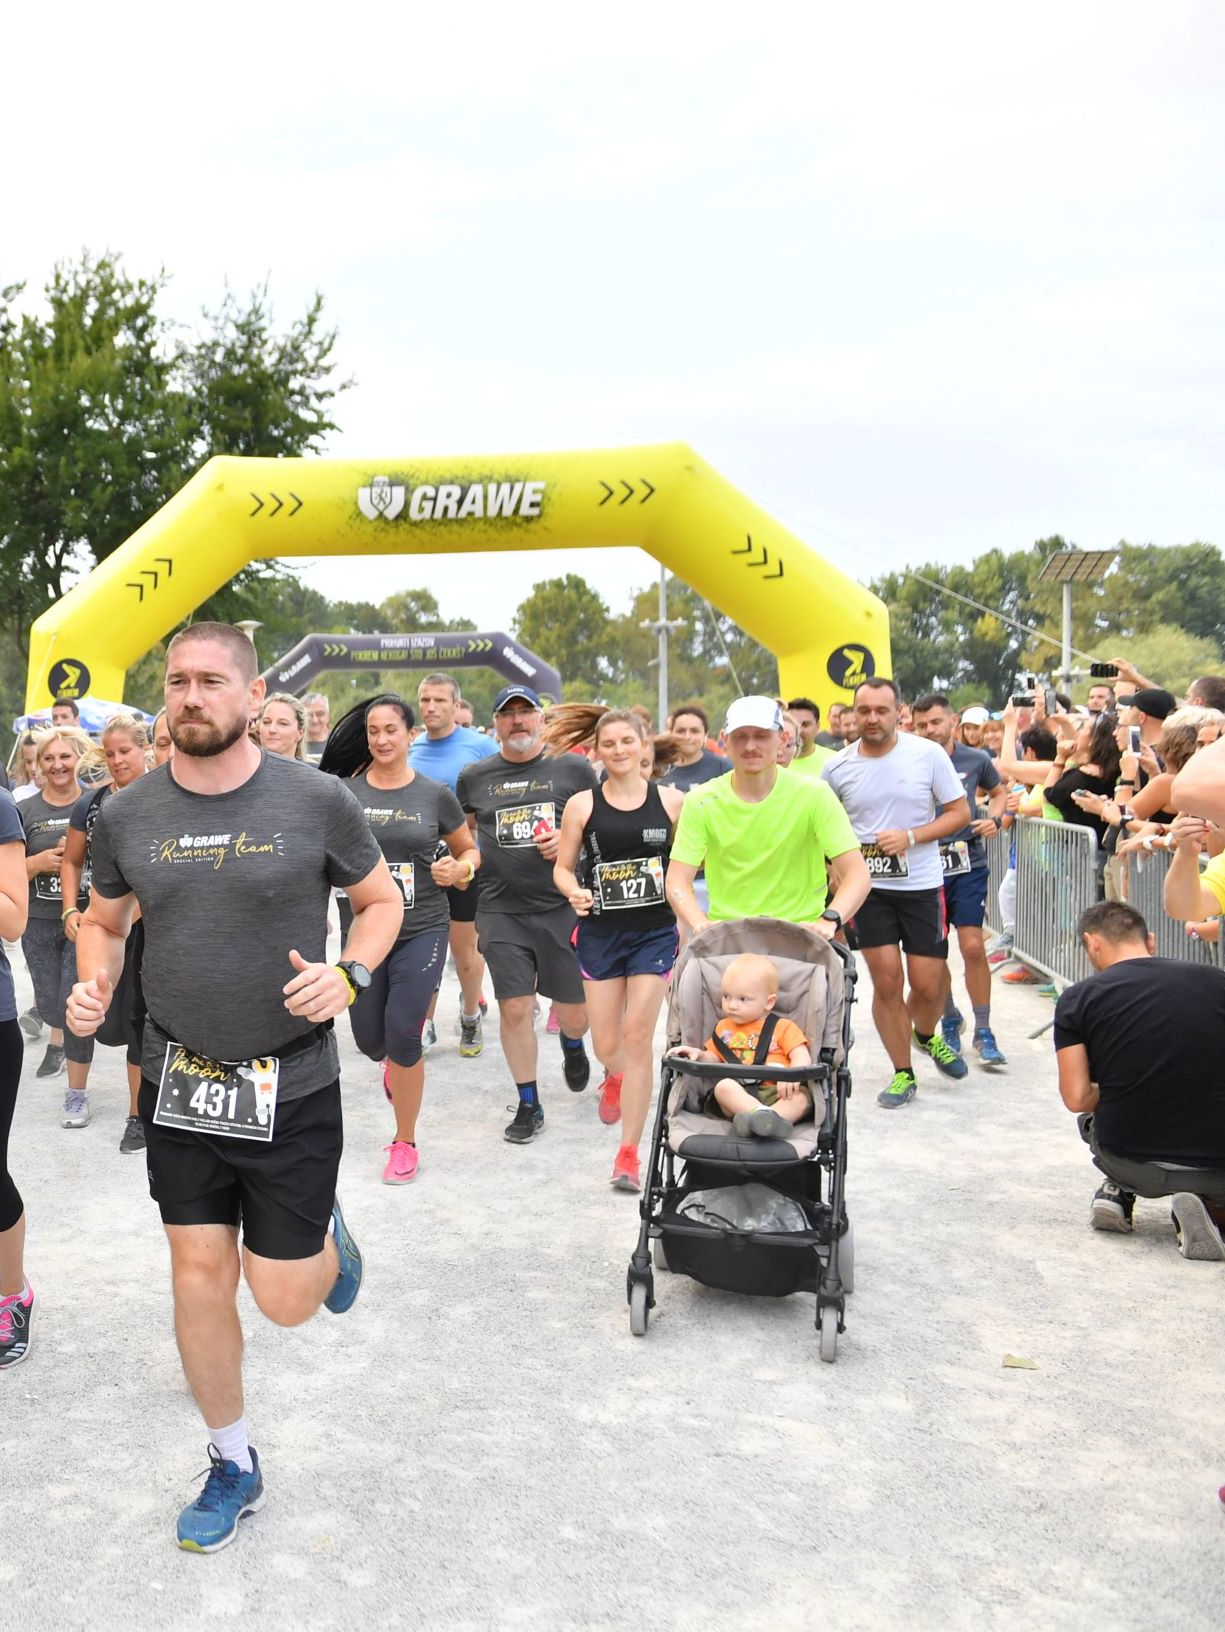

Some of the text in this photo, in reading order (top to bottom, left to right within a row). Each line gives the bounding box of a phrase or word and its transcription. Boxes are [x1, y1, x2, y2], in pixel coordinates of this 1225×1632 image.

[409, 481, 545, 520] GRAWE
[159, 831, 274, 870] Running team
[193, 834, 232, 847] GRAWE
[619, 877, 646, 899] 127
[189, 1081, 238, 1120] 431
